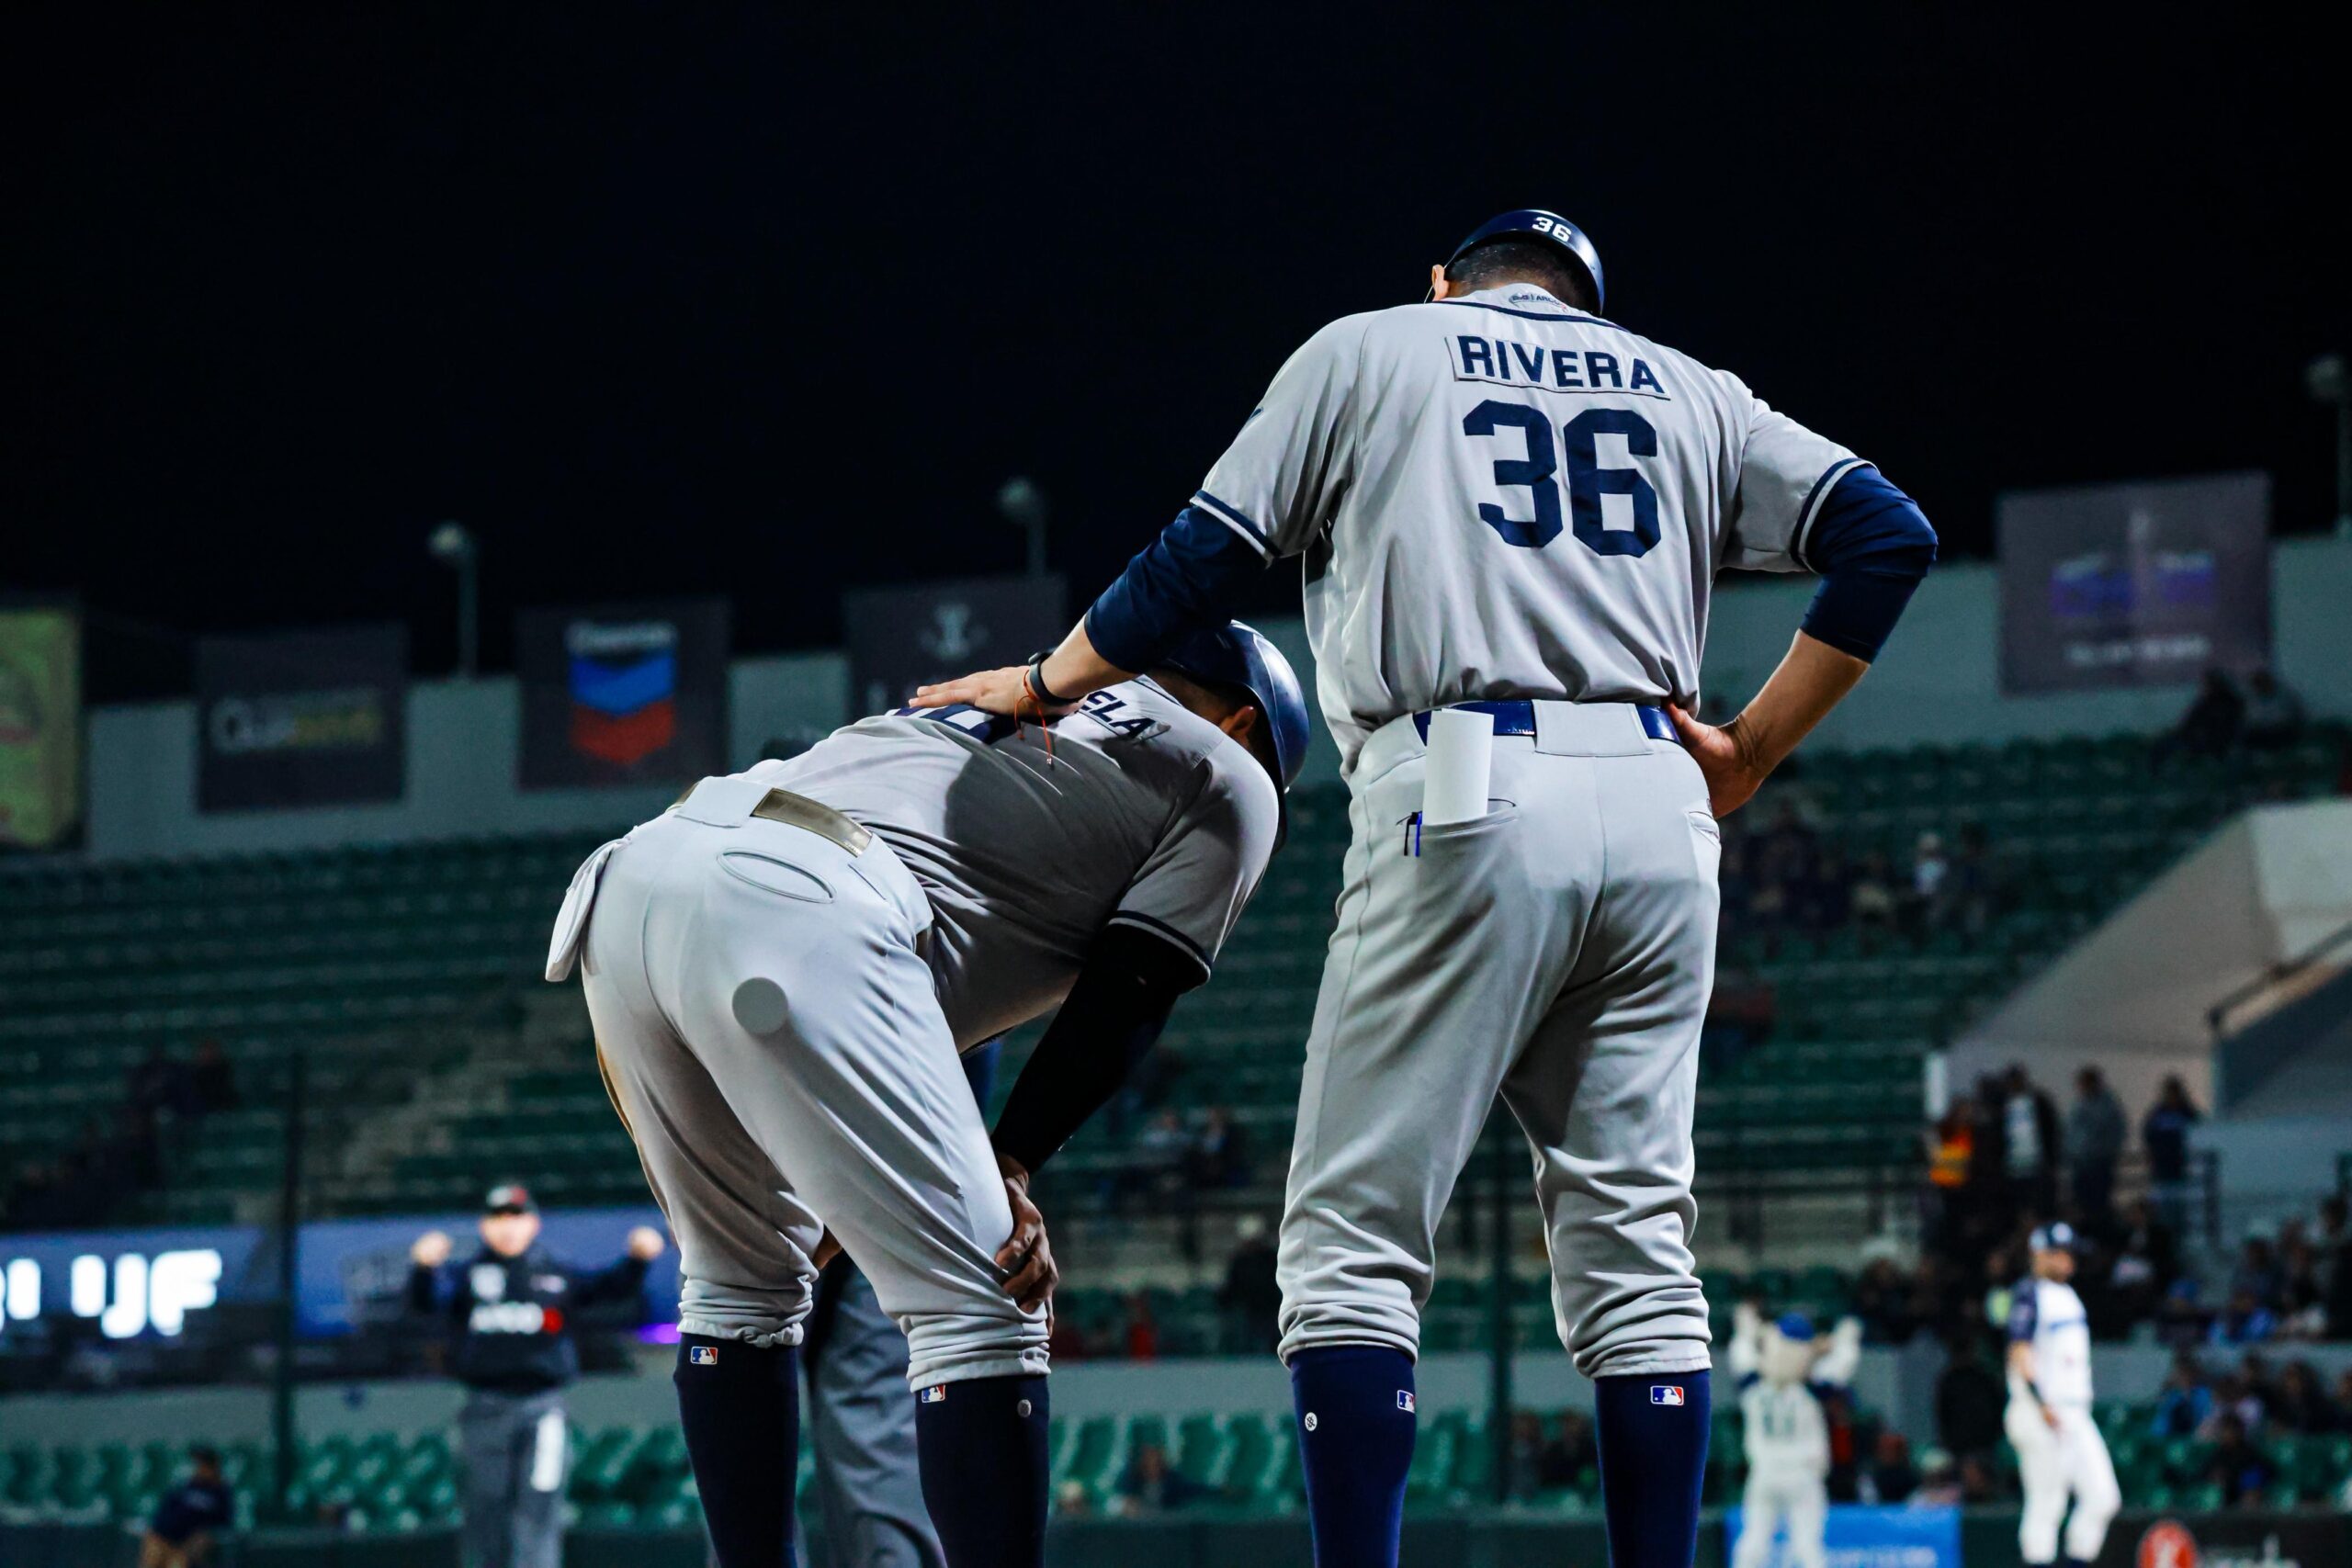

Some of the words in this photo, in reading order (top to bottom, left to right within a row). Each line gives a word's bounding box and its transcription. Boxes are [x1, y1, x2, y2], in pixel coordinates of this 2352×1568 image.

[1532, 216, 1572, 243] 36
[1456, 334, 1665, 394] RIVERA
[1462, 399, 1661, 558] 36
